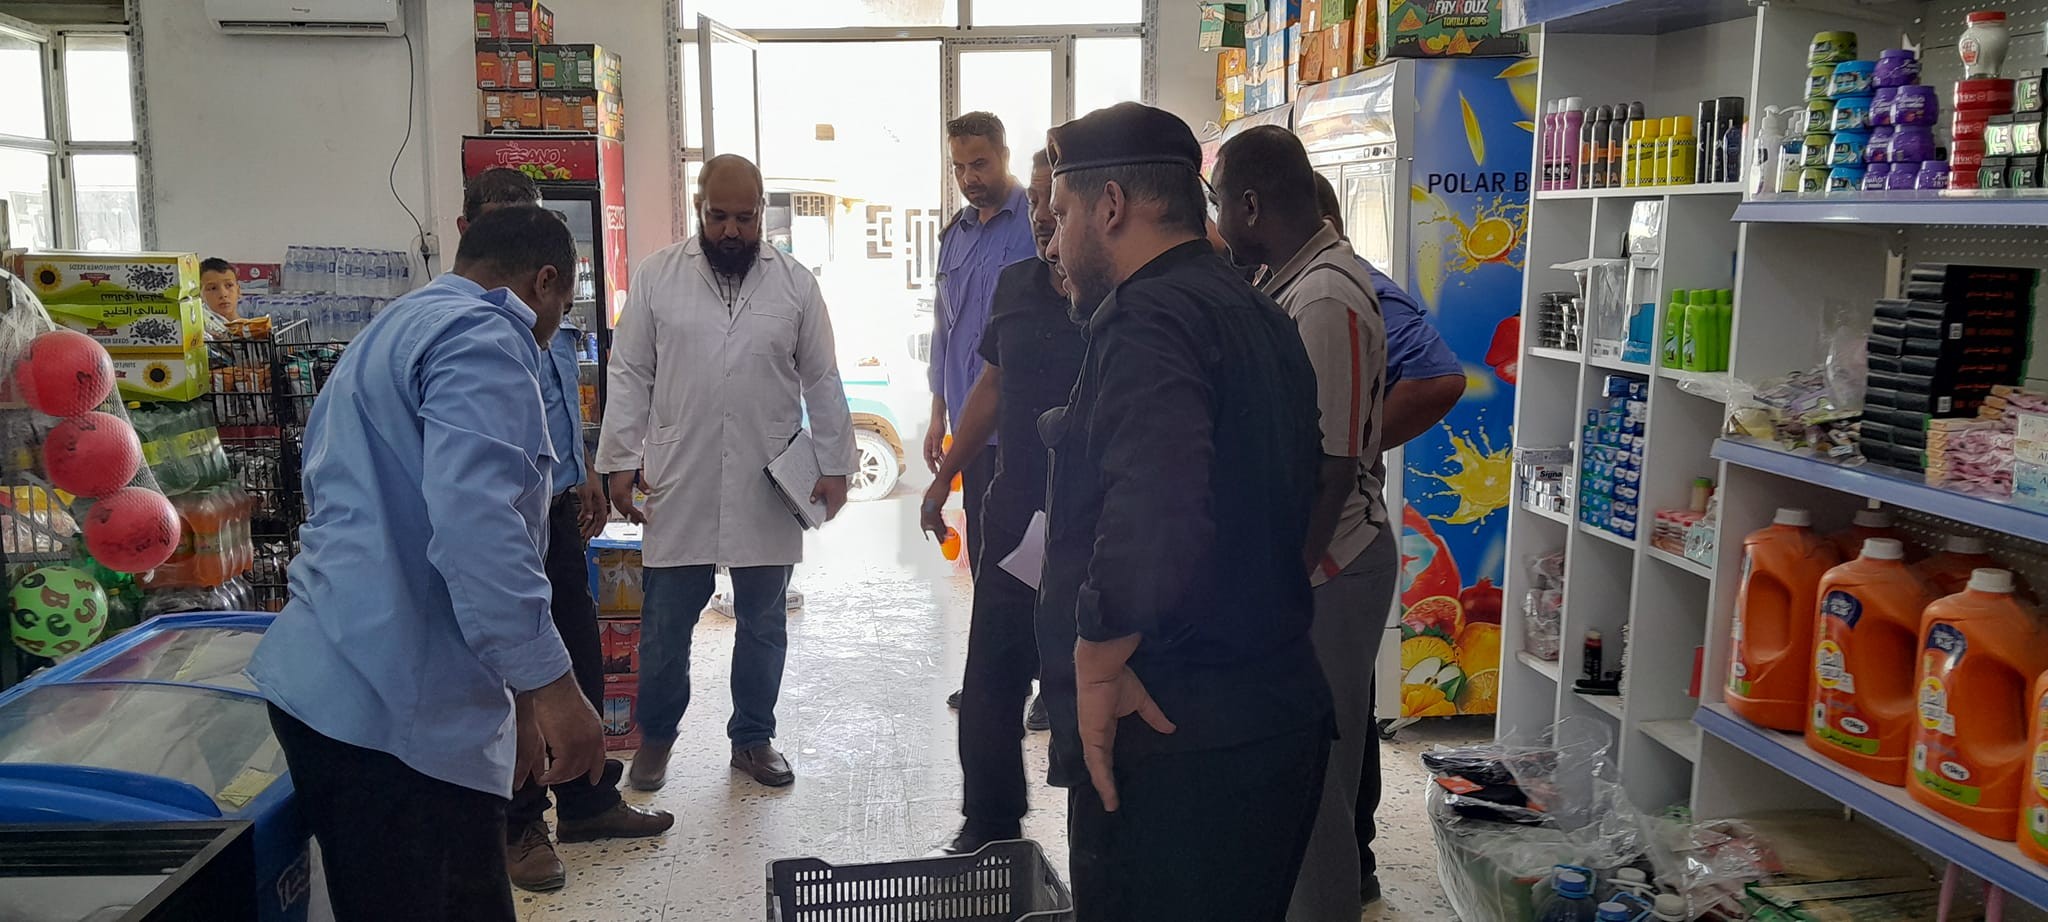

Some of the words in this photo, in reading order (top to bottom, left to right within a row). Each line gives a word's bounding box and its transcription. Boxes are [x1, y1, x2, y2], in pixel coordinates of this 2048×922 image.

[1443, 17, 1469, 26] TORTILLA
[1470, 16, 1487, 25] CHIPS
[496, 148, 561, 164] TESANO
[1428, 172, 1505, 194] POLAR
